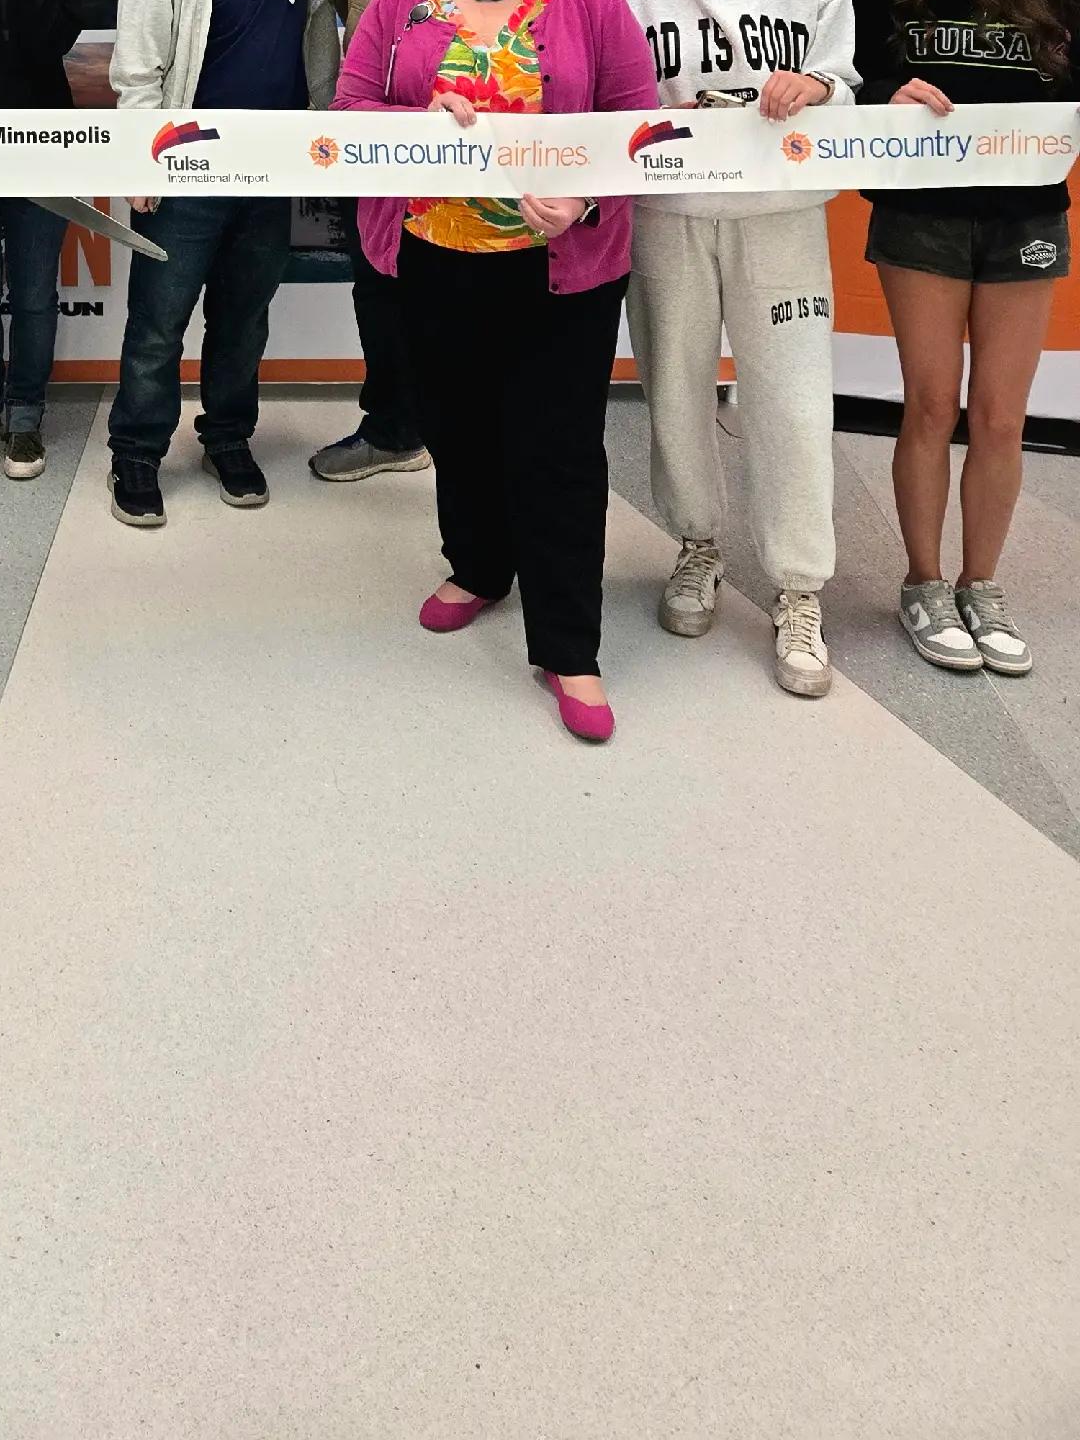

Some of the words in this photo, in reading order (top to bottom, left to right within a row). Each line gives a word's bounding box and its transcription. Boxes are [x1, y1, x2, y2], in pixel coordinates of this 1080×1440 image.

[646, 21, 682, 82] OD
[698, 17, 734, 74] IS
[738, 13, 810, 73] GOOD
[909, 27, 1032, 61] TULSA
[344, 142, 390, 165] sun
[394, 137, 493, 172] country
[818, 137, 865, 159] sun
[870, 129, 972, 163] country
[164, 155, 210, 171] Tulsa
[640, 154, 684, 169] Tulsa
[167, 173, 231, 183] International
[233, 172, 270, 184] Airport
[644, 171, 705, 182] International
[707, 170, 743, 182] Airport
[771, 300, 793, 325] GOD
[797, 297, 810, 319] IS
